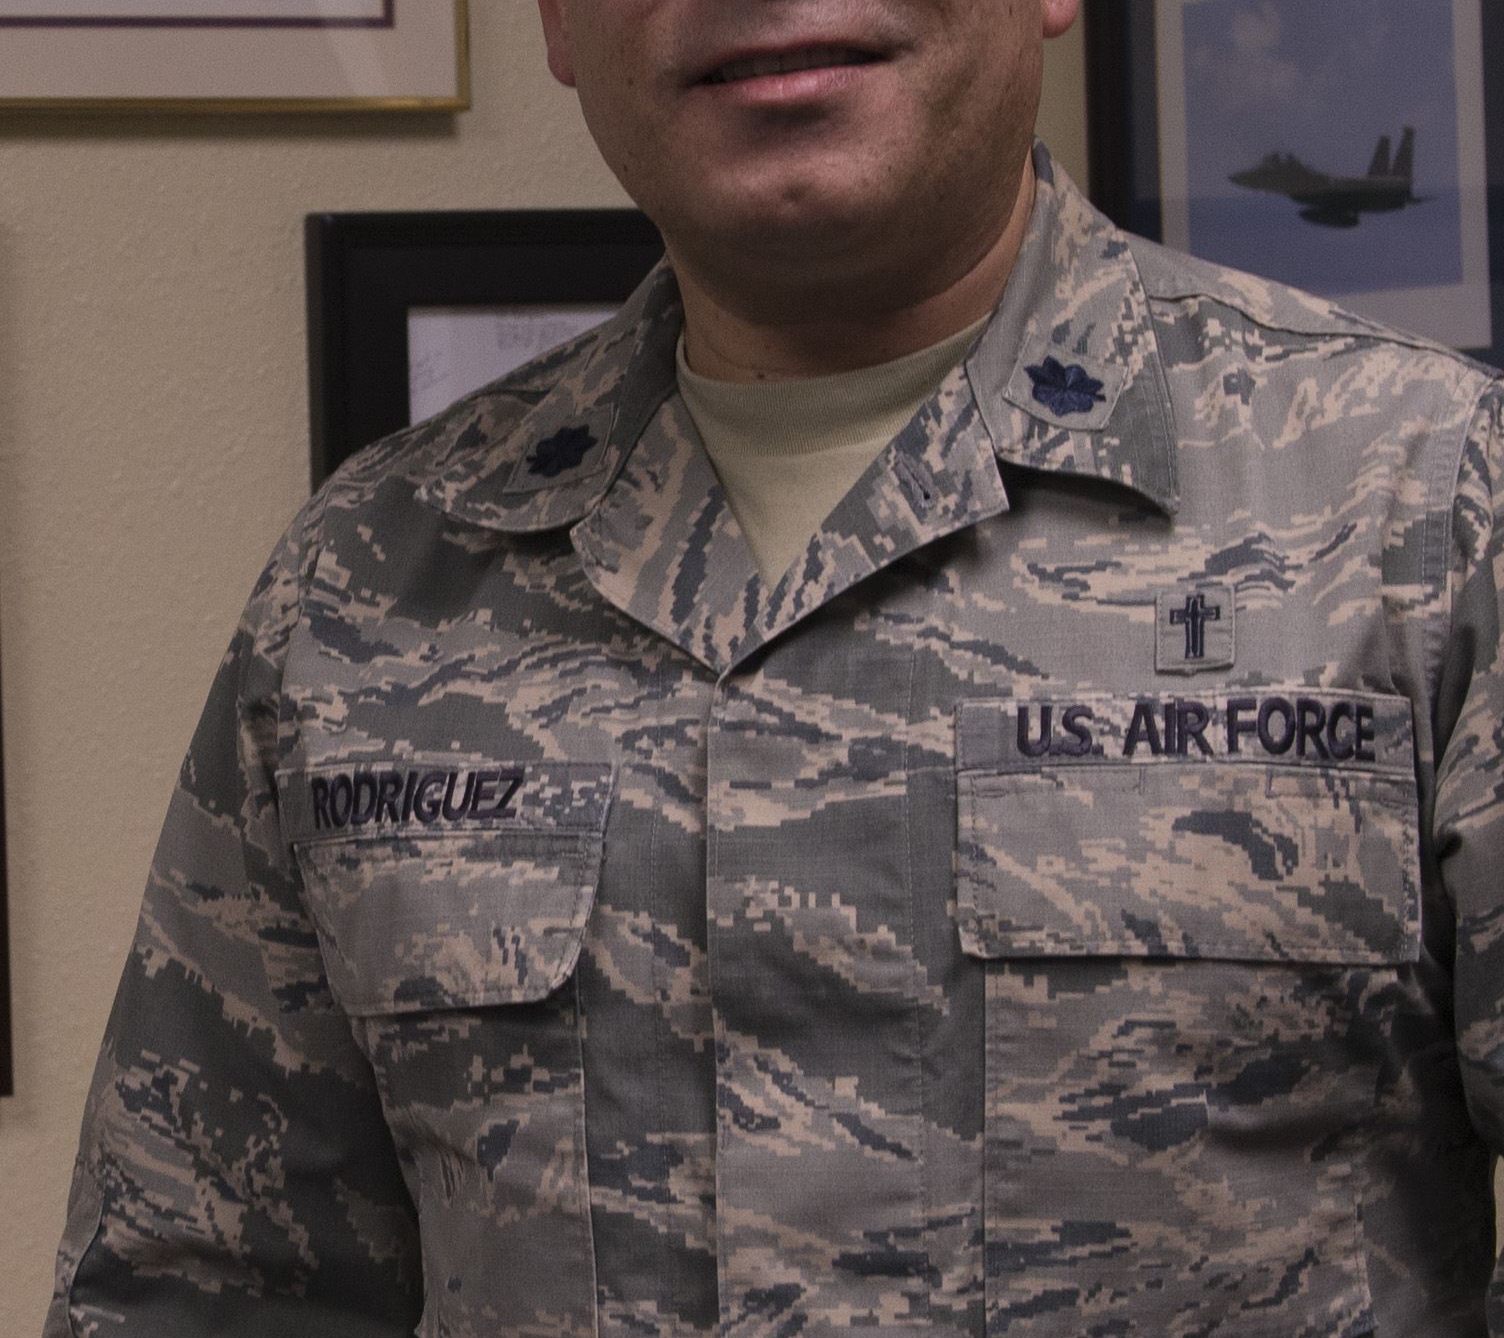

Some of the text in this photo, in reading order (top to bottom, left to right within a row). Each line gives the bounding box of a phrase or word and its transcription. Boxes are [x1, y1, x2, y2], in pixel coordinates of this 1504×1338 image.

[1017, 697, 1376, 760] U.S. AIR FORCE
[311, 767, 525, 829] RODRIGUEZ
